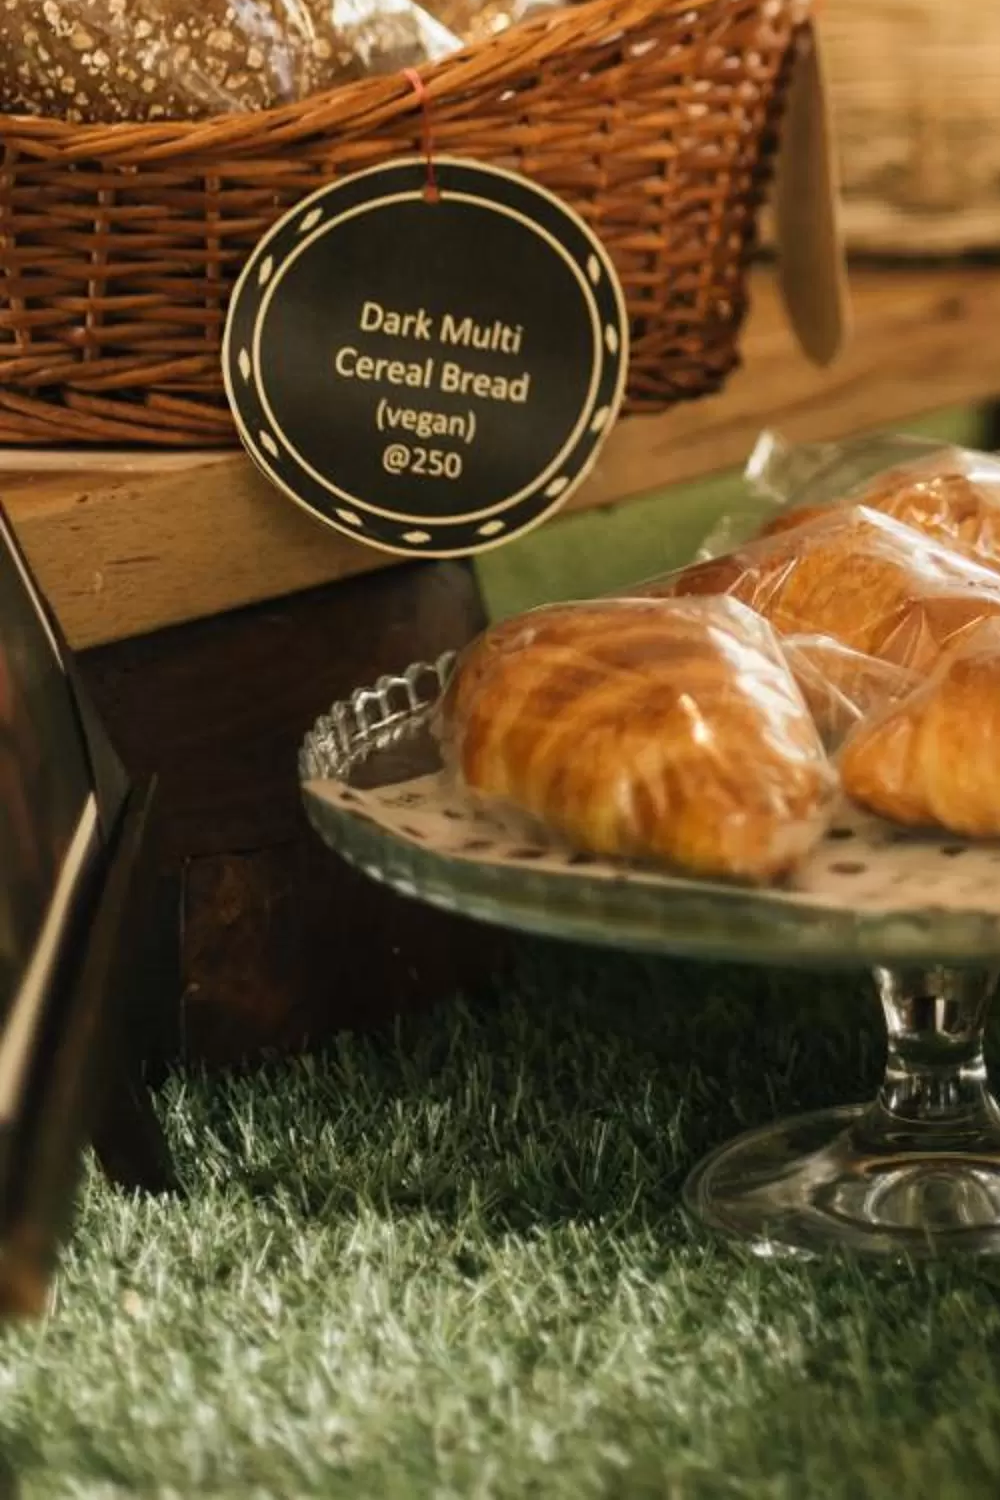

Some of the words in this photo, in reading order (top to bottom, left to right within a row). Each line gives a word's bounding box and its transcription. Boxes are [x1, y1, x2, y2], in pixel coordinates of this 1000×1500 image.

[360, 302, 432, 340] Dark
[440, 314, 523, 354] Multi
[335, 347, 434, 389] Cereal
[440, 362, 530, 403] Bread
[376, 398, 476, 443] (vegan)
[383, 444, 462, 479] @250
